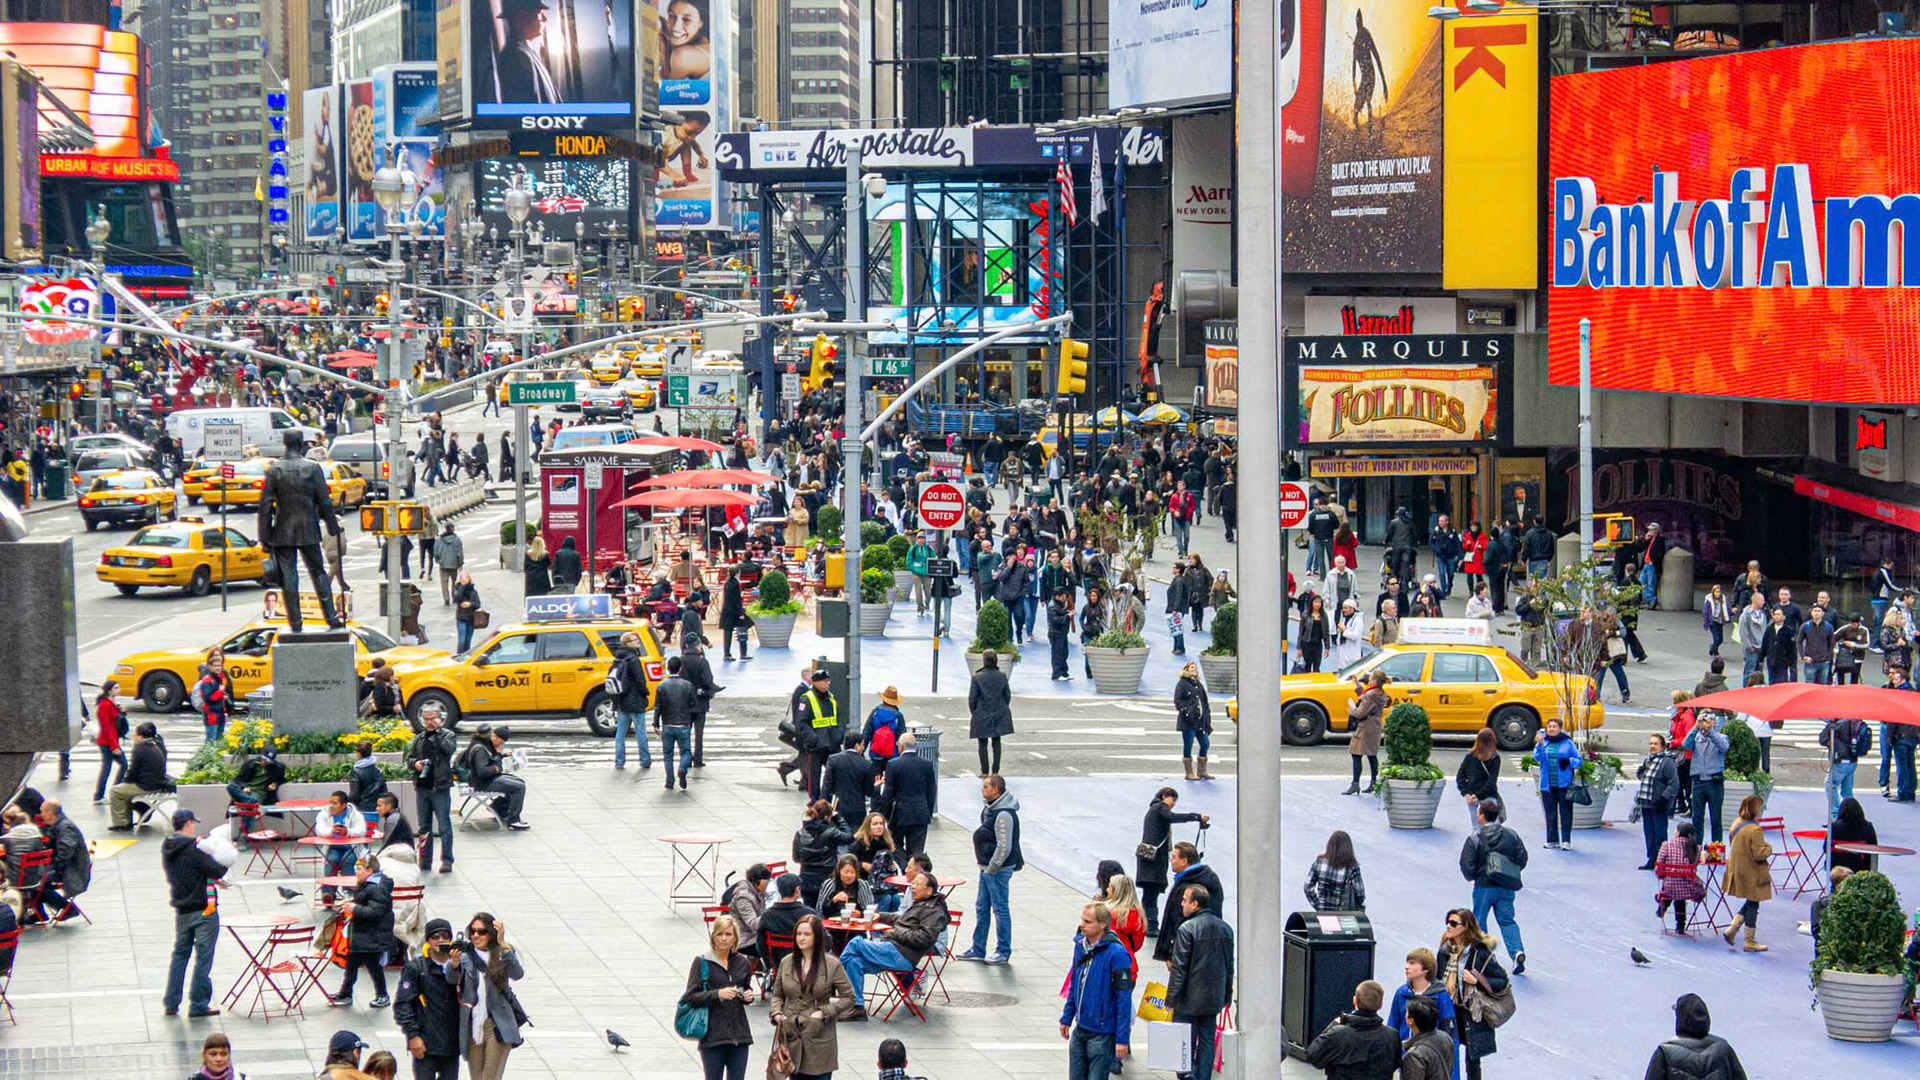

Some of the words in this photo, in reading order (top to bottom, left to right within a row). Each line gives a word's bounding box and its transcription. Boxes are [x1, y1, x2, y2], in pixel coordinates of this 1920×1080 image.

[665, 83, 691, 92] Golden
[679, 90, 700, 99] Rings
[521, 116, 587, 128] SONY
[555, 136, 606, 155] HONDA
[806, 128, 966, 168] Aérpostale
[45, 159, 87, 172] URBAN
[112, 163, 163, 176] MUSIC'S
[1331, 162, 1349, 180] BUILT
[1350, 161, 1365, 178] FOR
[1365, 160, 1379, 177] THE
[1379, 158, 1397, 176] WAY
[1395, 157, 1412, 175] YOU
[1413, 156, 1431, 174] PLAY.
[1176, 207, 1198, 215] NEW
[1201, 207, 1227, 215] YORK
[1299, 340, 1500, 359] MARQUIS
[874, 361, 883, 373] W
[886, 360, 898, 374] 46
[901, 360, 908, 368] ST
[519, 387, 567, 401] Broadway
[1328, 384, 1467, 440] FOLLIES
[1373, 461, 1409, 472] VIBRANT
[1412, 460, 1429, 471] AND
[927, 492, 939, 500] DO
[941, 492, 957, 500] NOT
[1285, 491, 1300, 499] NOT
[928, 512, 954, 521] ENTER
[528, 603, 571, 614] ALDO
[229, 665, 261, 679] TAXI
[496, 675, 530, 688] TAXI
